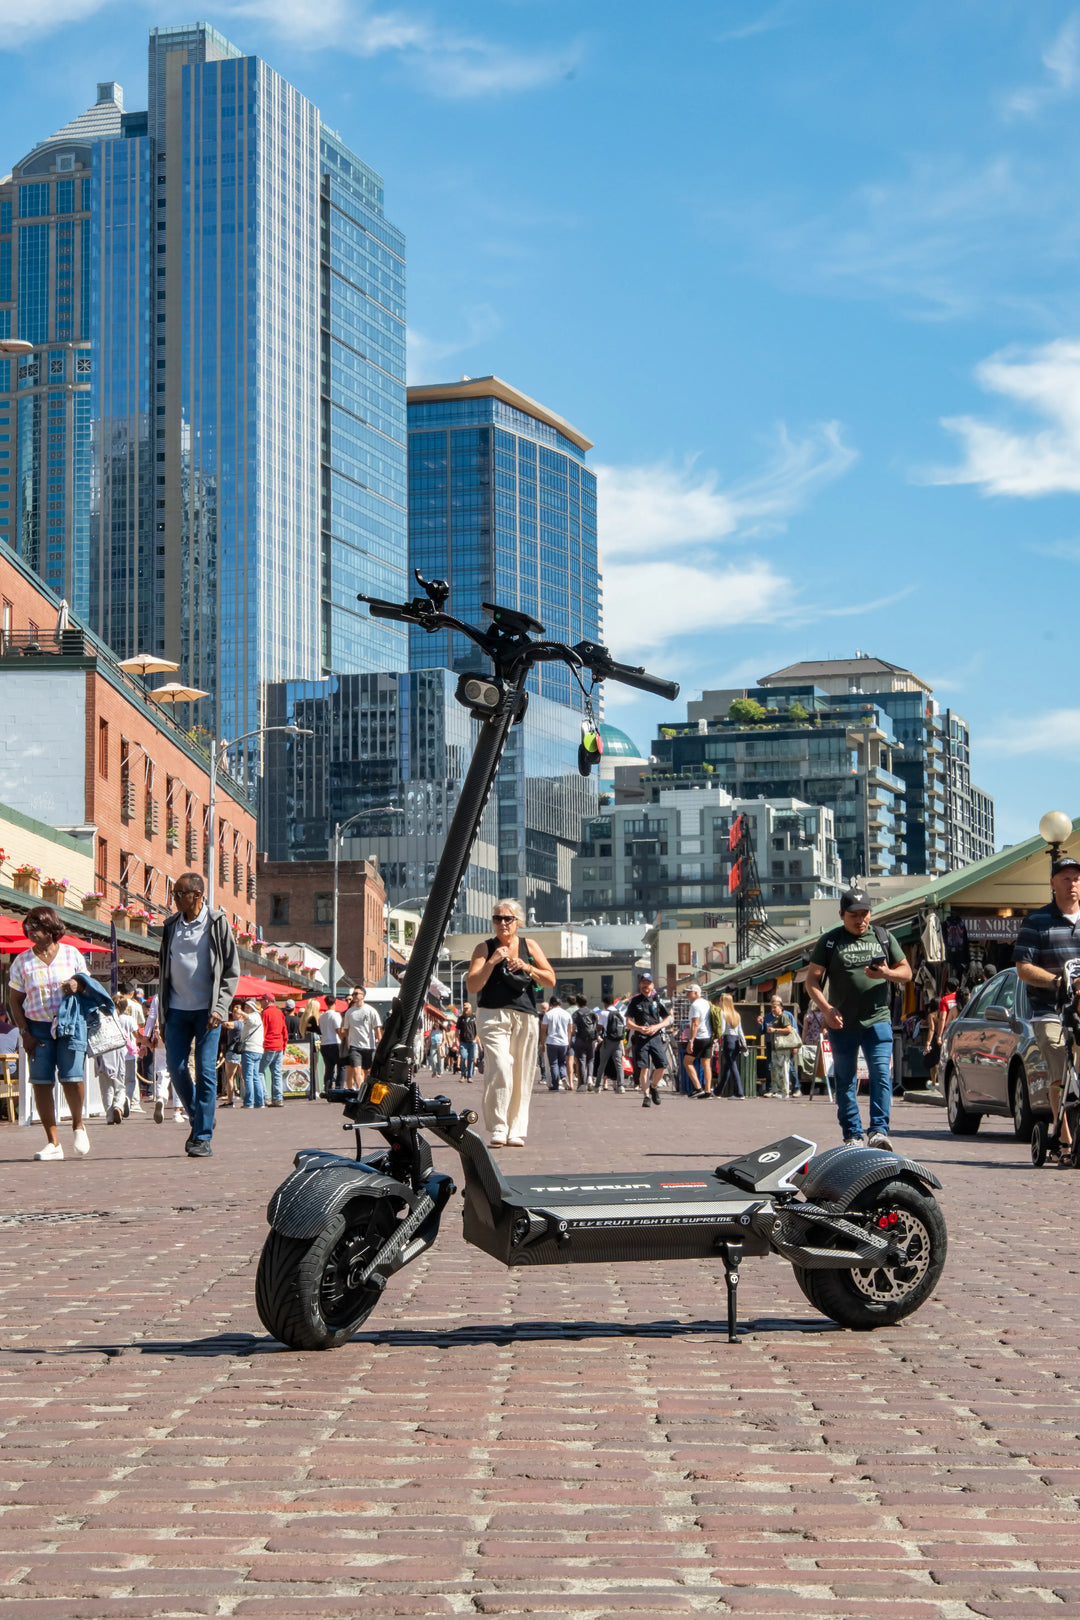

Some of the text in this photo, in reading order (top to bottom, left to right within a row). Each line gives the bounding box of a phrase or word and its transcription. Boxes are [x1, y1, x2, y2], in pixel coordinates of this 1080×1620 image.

[962, 919, 1024, 933] HE NORT
[843, 953, 876, 968] Strea
[572, 1219, 631, 1227] TEVERUN
